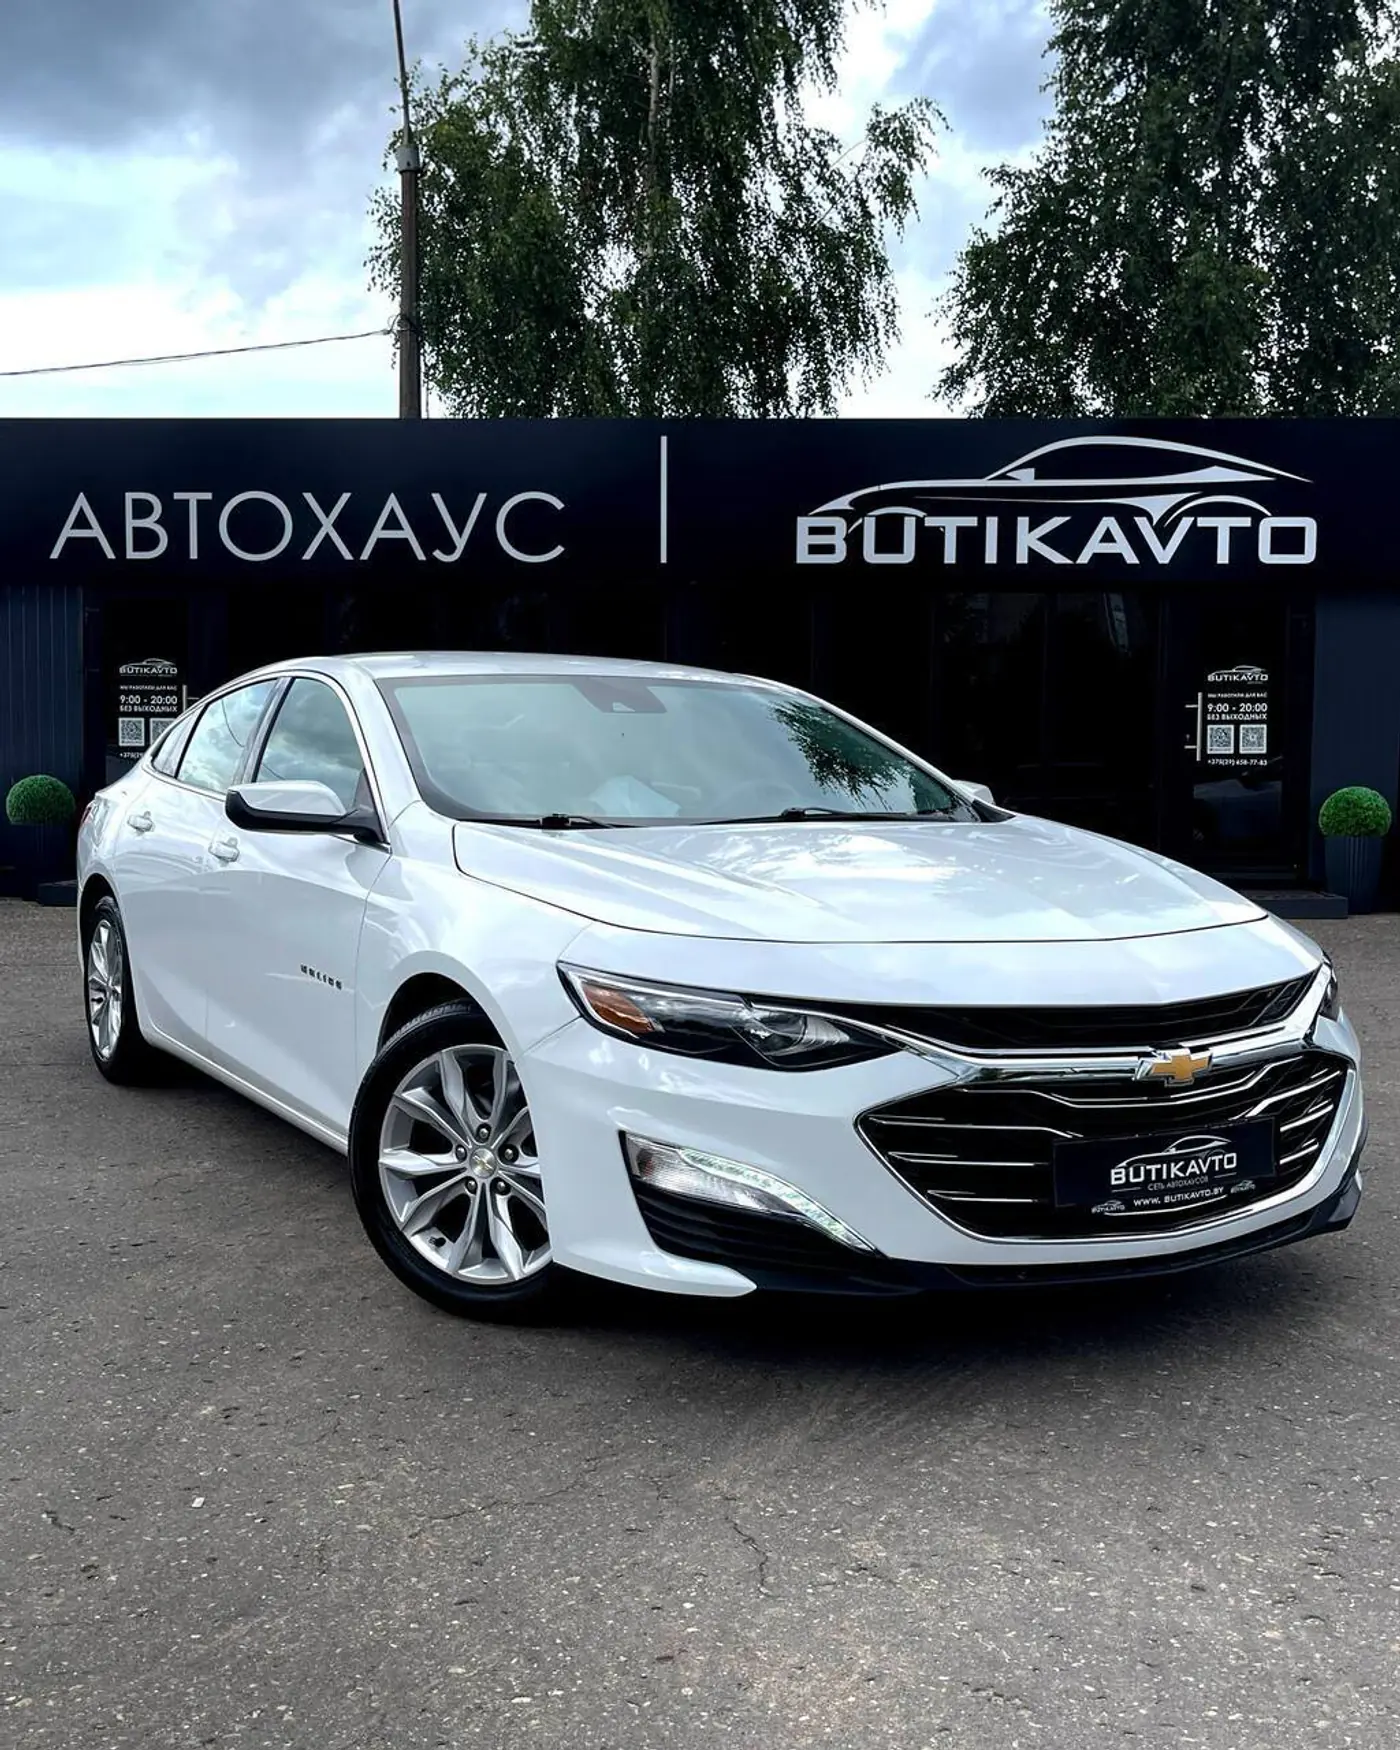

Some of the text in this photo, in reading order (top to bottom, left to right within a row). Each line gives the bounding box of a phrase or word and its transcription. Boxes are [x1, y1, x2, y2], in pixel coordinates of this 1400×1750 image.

[49, 489, 567, 564] АВТОХАУС
[795, 515, 1318, 565] BUTIKAVTO
[1207, 674, 1269, 682] BUTIKAVTO
[120, 694, 141, 704] 9:00
[150, 695, 178, 704] 20:00
[1207, 702, 1229, 712] 9:00
[1239, 703, 1268, 712] 20:00
[1110, 1152, 1237, 1185] BUTIKAVTO
[1133, 1196, 1161, 1207] WWW.
[1164, 1186, 1224, 1203] BUTIKAVTO.BY
